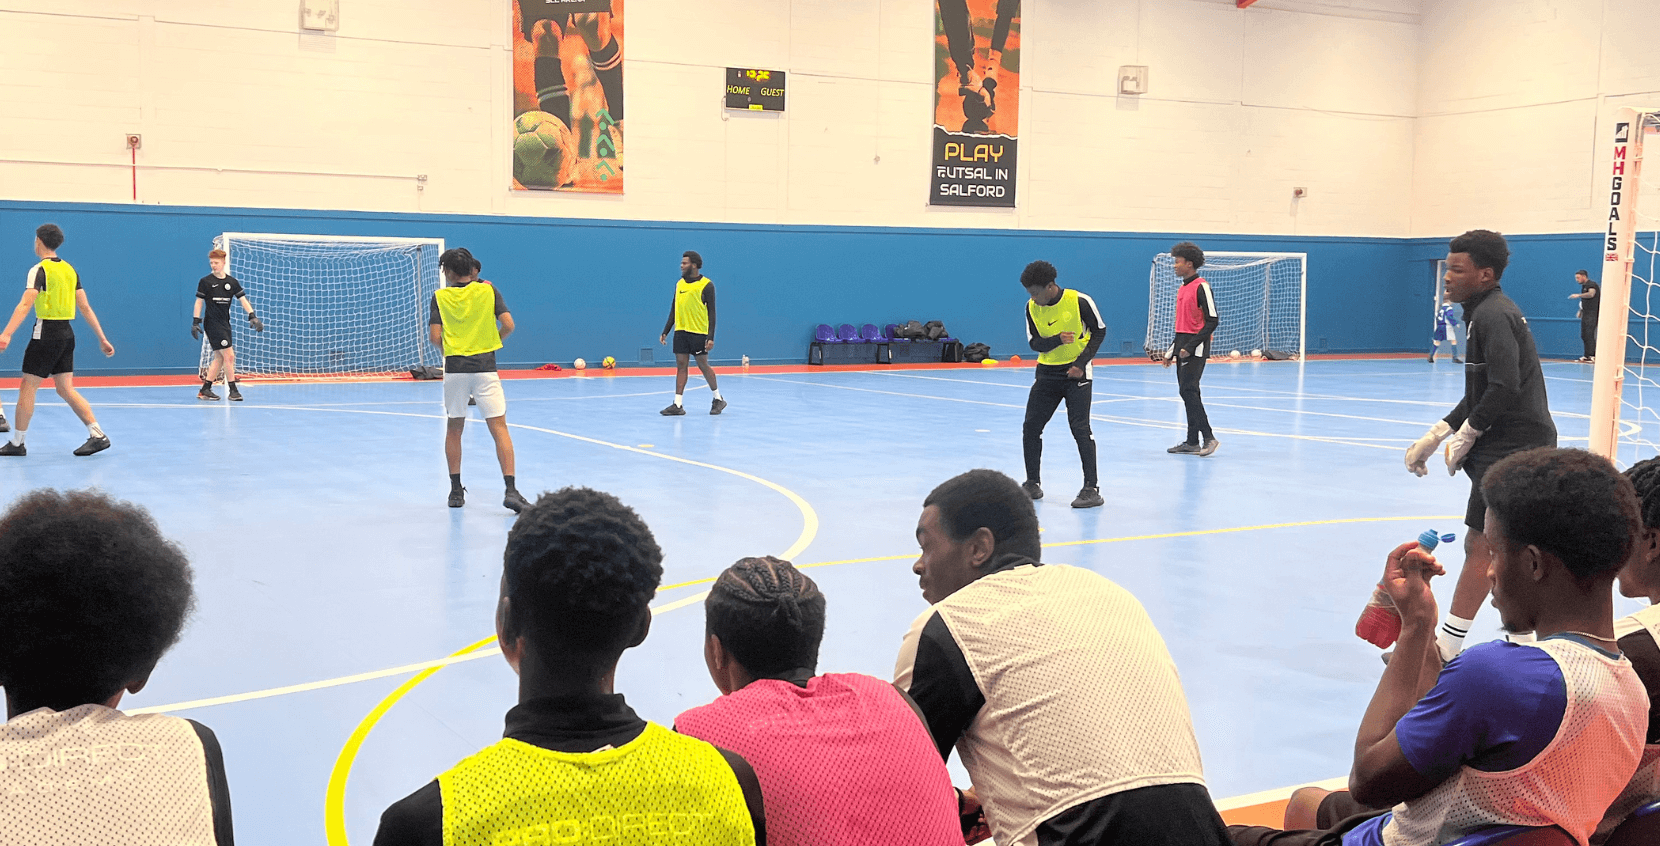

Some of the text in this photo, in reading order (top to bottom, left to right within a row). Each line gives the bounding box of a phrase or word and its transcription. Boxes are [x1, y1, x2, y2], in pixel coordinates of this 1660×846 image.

[726, 84, 785, 97] HOME GUEST
[944, 142, 1004, 163] PLAY
[936, 165, 1009, 181] FUTSAL IN
[939, 183, 1006, 198] SALFORD
